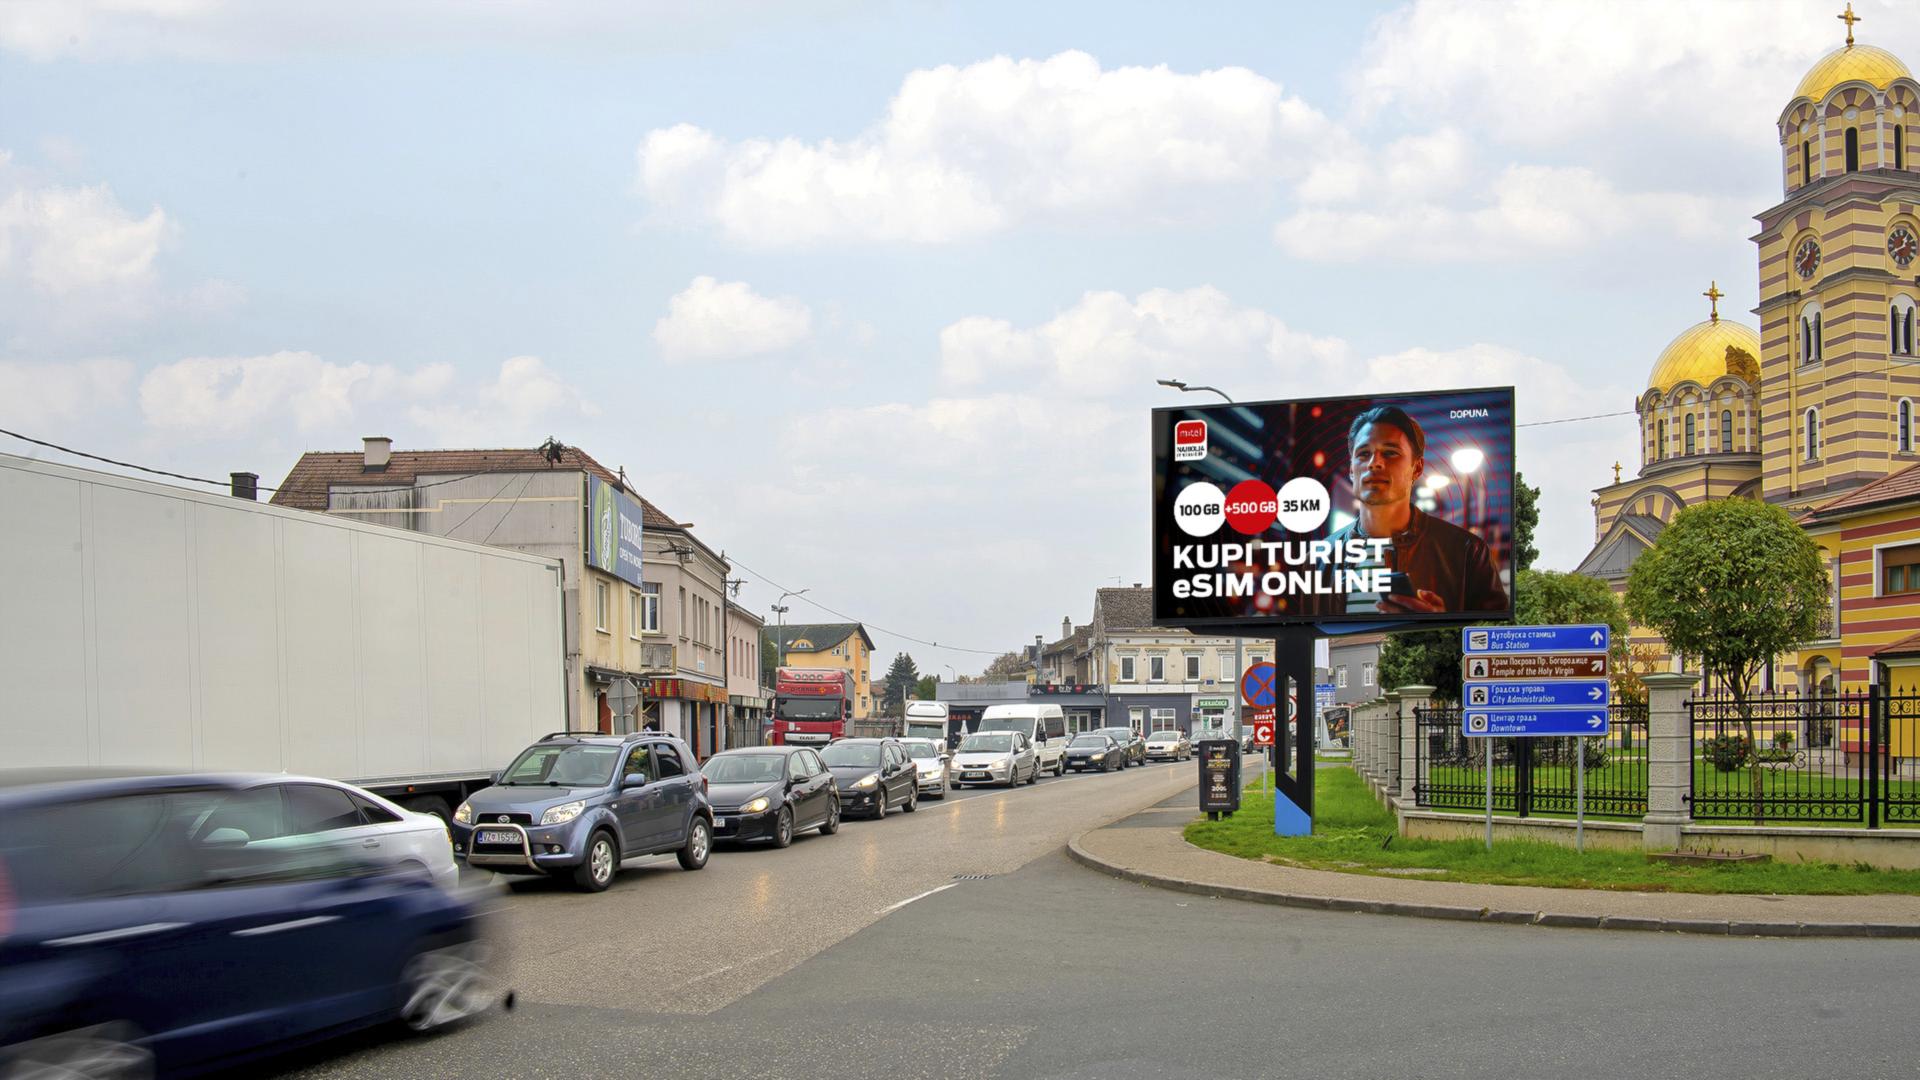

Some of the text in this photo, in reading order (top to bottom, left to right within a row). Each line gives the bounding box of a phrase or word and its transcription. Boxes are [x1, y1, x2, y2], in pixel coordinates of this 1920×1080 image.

[1449, 408, 1489, 419] DOPUNA
[1179, 502, 1220, 517] 100 GB
[1224, 500, 1277, 515] +500 GB
[1282, 498, 1321, 513] 35 KM
[1173, 537, 1393, 569] KUPI TURIST
[1173, 568, 1393, 599] eSIM ONLINE
[1491, 631, 1556, 641] Аутобуска станица
[1491, 640, 1530, 649] Bus Station
[1491, 656, 1588, 666] Храм Покрова Пр. Богородице
[1491, 668, 1515, 677] Temple
[1516, 668, 1524, 676] of
[1538, 667, 1553, 676] Holy
[1554, 667, 1575, 676] Virgin
[1491, 685, 1545, 694] Градска управа
[1491, 694, 1556, 705] City Administration
[1490, 714, 1537, 723] Центар града
[1491, 724, 1526, 733] Downtown
